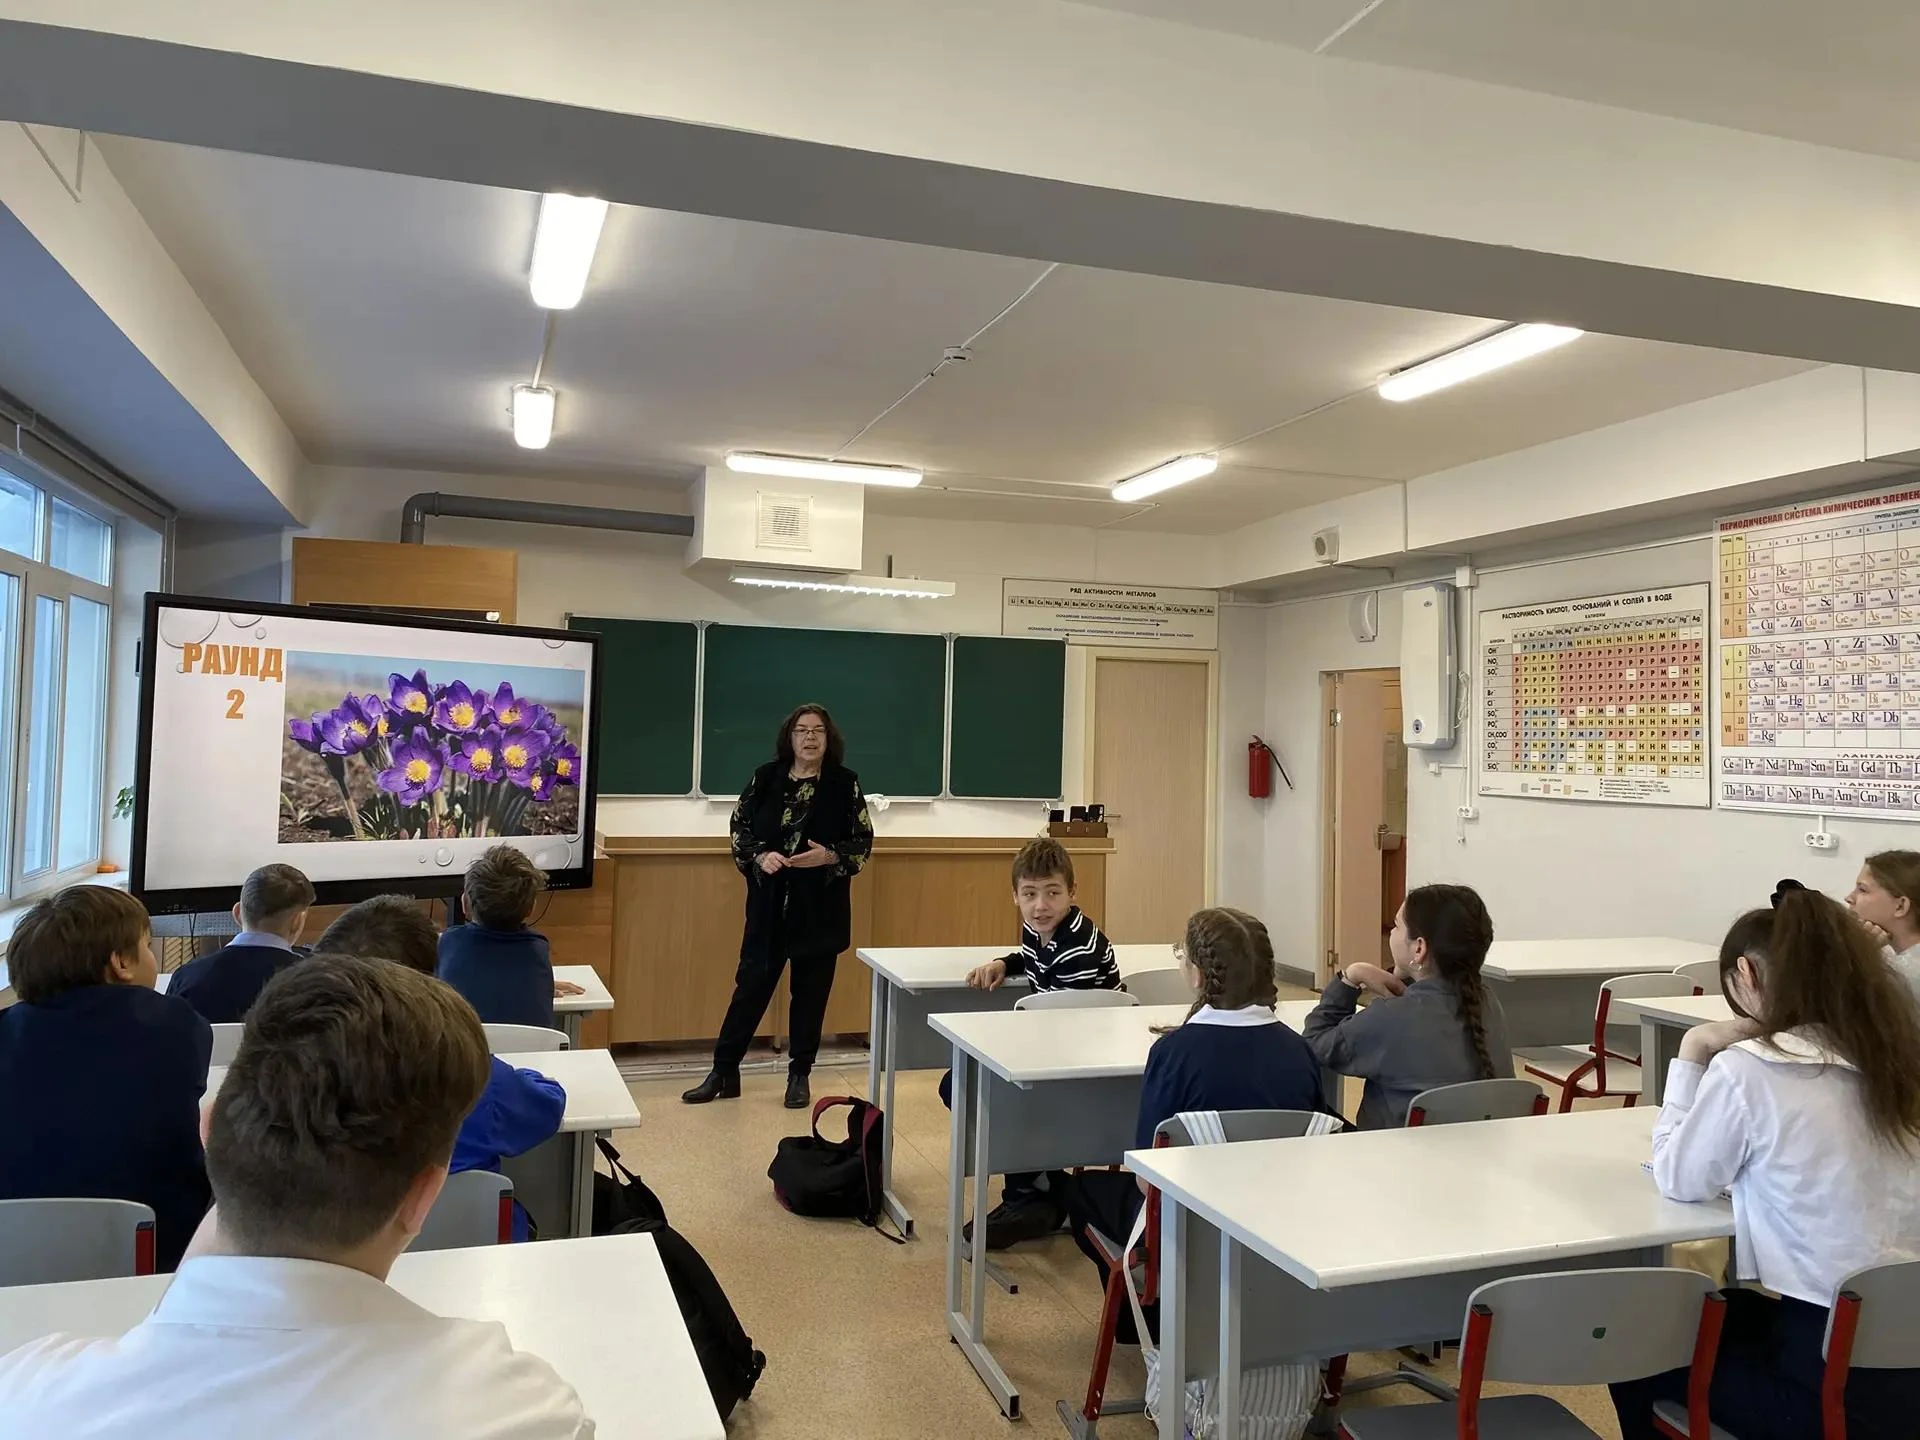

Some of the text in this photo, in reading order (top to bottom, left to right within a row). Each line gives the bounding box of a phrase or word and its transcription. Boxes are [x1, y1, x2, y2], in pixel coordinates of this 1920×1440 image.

[1720, 514, 1783, 531] ПЕРИОДИЧЕСКАЯ
[1784, 506, 1822, 520] СИСТЕМА
[1823, 496, 1882, 514] ХИМИЧЕСКИХ
[1748, 552, 1756, 562] H
[1748, 569, 1756, 579] Li
[1776, 566, 1787, 576] Be
[1835, 558, 1842, 568] C
[1867, 553, 1876, 565] N
[1900, 549, 1909, 560] O
[1776, 583, 1790, 594] Mg
[1867, 573, 1875, 584] P
[1502, 610, 1545, 620] РАСТВОРИМОСТЬ
[1546, 606, 1570, 615] КИСЛОТ,
[1572, 599, 1611, 611] ОСНОВАНИЙ
[1622, 595, 1644, 605] СОЛЕЙ
[1655, 593, 1673, 601] ВОДЕ
[1748, 604, 1756, 614] K
[1776, 601, 1787, 611] Ca
[1820, 596, 1832, 606] Sc
[1853, 592, 1864, 603] Ti
[1888, 589, 1897, 600] V
[1761, 620, 1773, 630] Cu
[1790, 617, 1802, 627] Zn
[1805, 616, 1817, 626] Ga
[1835, 613, 1849, 624] Ge
[1868, 610, 1880, 621] As
[1901, 607, 1913, 618] Se
[1748, 644, 1760, 655] Rb
[1824, 639, 1832, 650] Y
[1853, 638, 1864, 648] Zr
[1882, 635, 1898, 647] Nb
[182, 642, 284, 682] РАУНД
[1762, 661, 1774, 674] Ag
[1789, 660, 1803, 670] Cd
[1836, 657, 1848, 668] Sn
[1868, 656, 1880, 666] Sb
[1748, 679, 1759, 689] Cs
[1851, 674, 1864, 685] Hf
[1886, 673, 1898, 684] Ta
[224, 688, 244, 720] 2
[1762, 696, 1774, 706] Au
[1789, 695, 1802, 708] Hg
[1836, 694, 1849, 704] Pb
[1903, 692, 1916, 703] Po
[1749, 713, 1758, 723] Fr
[1777, 713, 1789, 723] Ra
[1852, 712, 1865, 722] Rf
[1883, 712, 1899, 723] Db
[1762, 730, 1774, 743] Rg
[1723, 758, 1734, 769] Ce
[1745, 759, 1754, 769] Pr
[1766, 759, 1779, 770] Nd
[1788, 760, 1803, 770] Pm
[1810, 760, 1826, 772] Sm
[1836, 760, 1848, 772] Eu
[1861, 762, 1876, 773] Gd
[1887, 762, 1902, 774] Tb
[1724, 784, 1736, 795] Th
[1745, 785, 1754, 796] Pa
[1767, 786, 1774, 797] U
[1788, 787, 1802, 800] Np
[1812, 788, 1824, 800] Pu
[1835, 789, 1852, 800] Am
[1860, 791, 1878, 802] Cm
[1888, 792, 1901, 804] Bk
